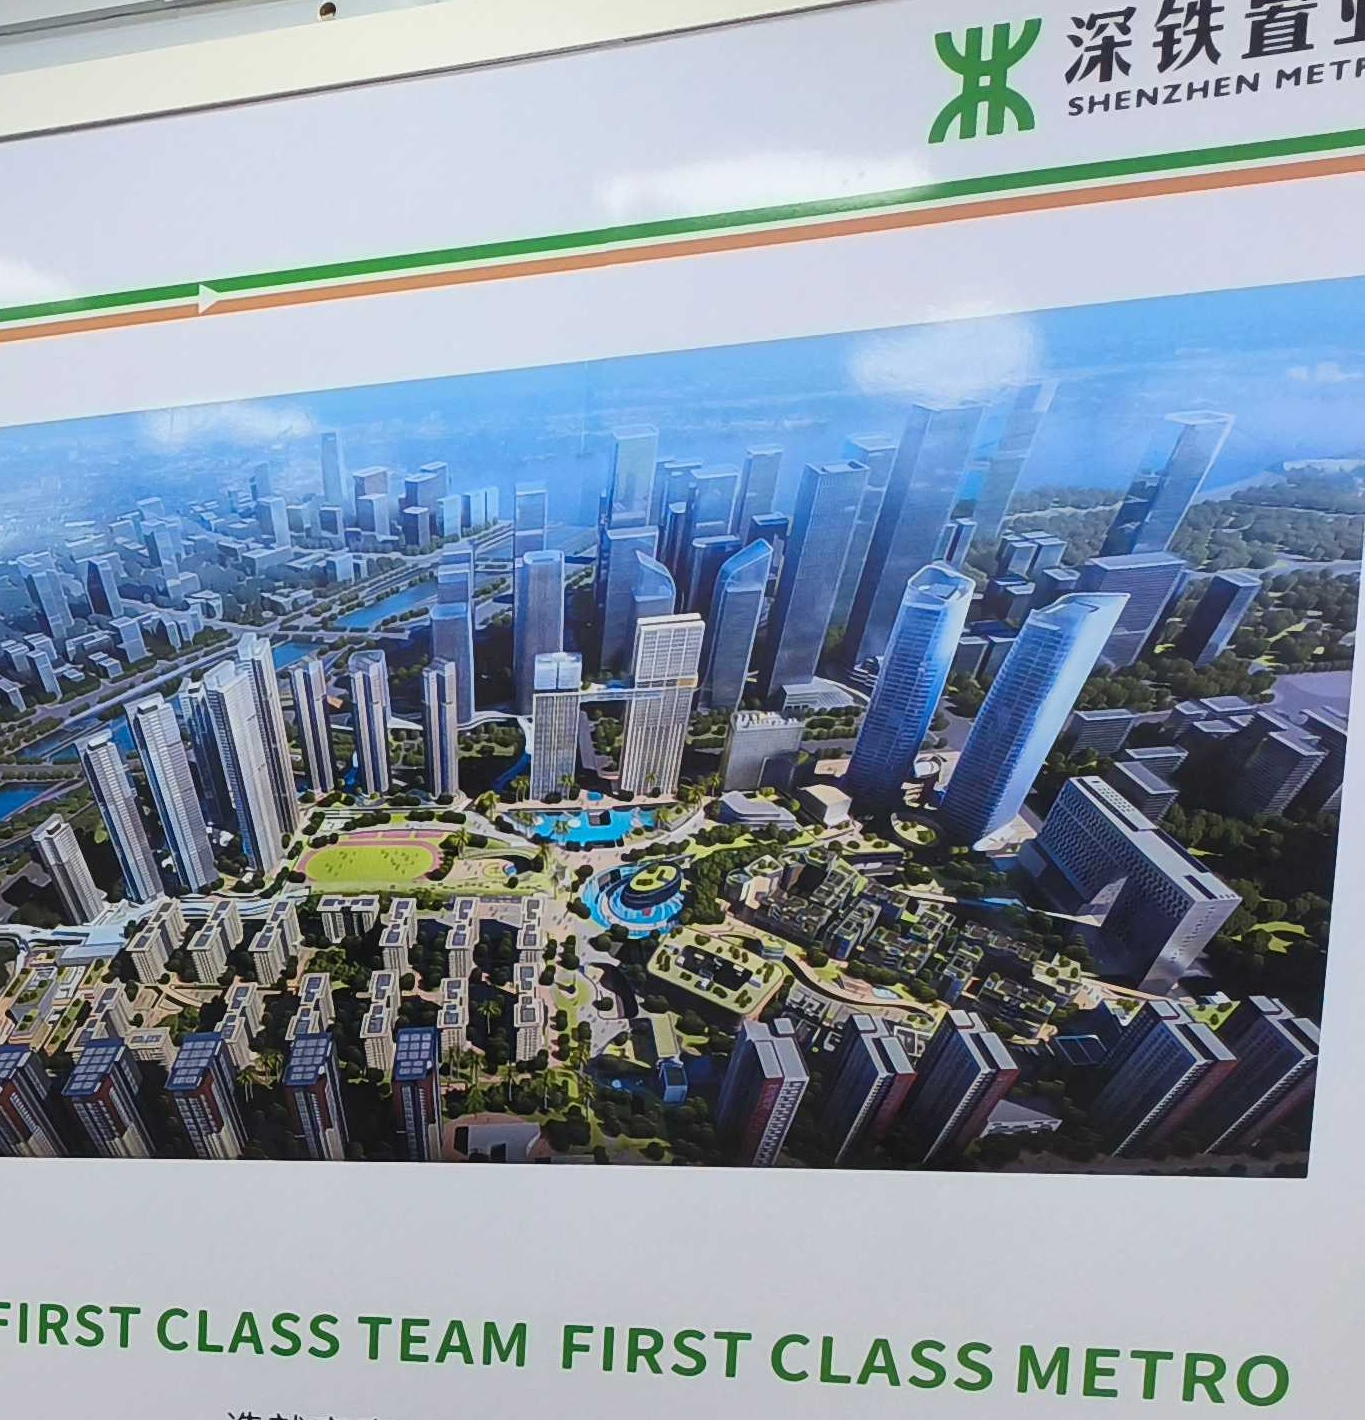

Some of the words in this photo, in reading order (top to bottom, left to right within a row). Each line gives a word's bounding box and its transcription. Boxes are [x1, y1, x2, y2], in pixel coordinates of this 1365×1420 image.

[1067, 72, 1260, 117] SHENZHEN
[157, 1308, 341, 1360] CLASS
[359, 1315, 528, 1368] TEAM
[562, 1324, 752, 1379] FIRST
[771, 1333, 995, 1393] CLASS
[1018, 1344, 1290, 1407] METRO
